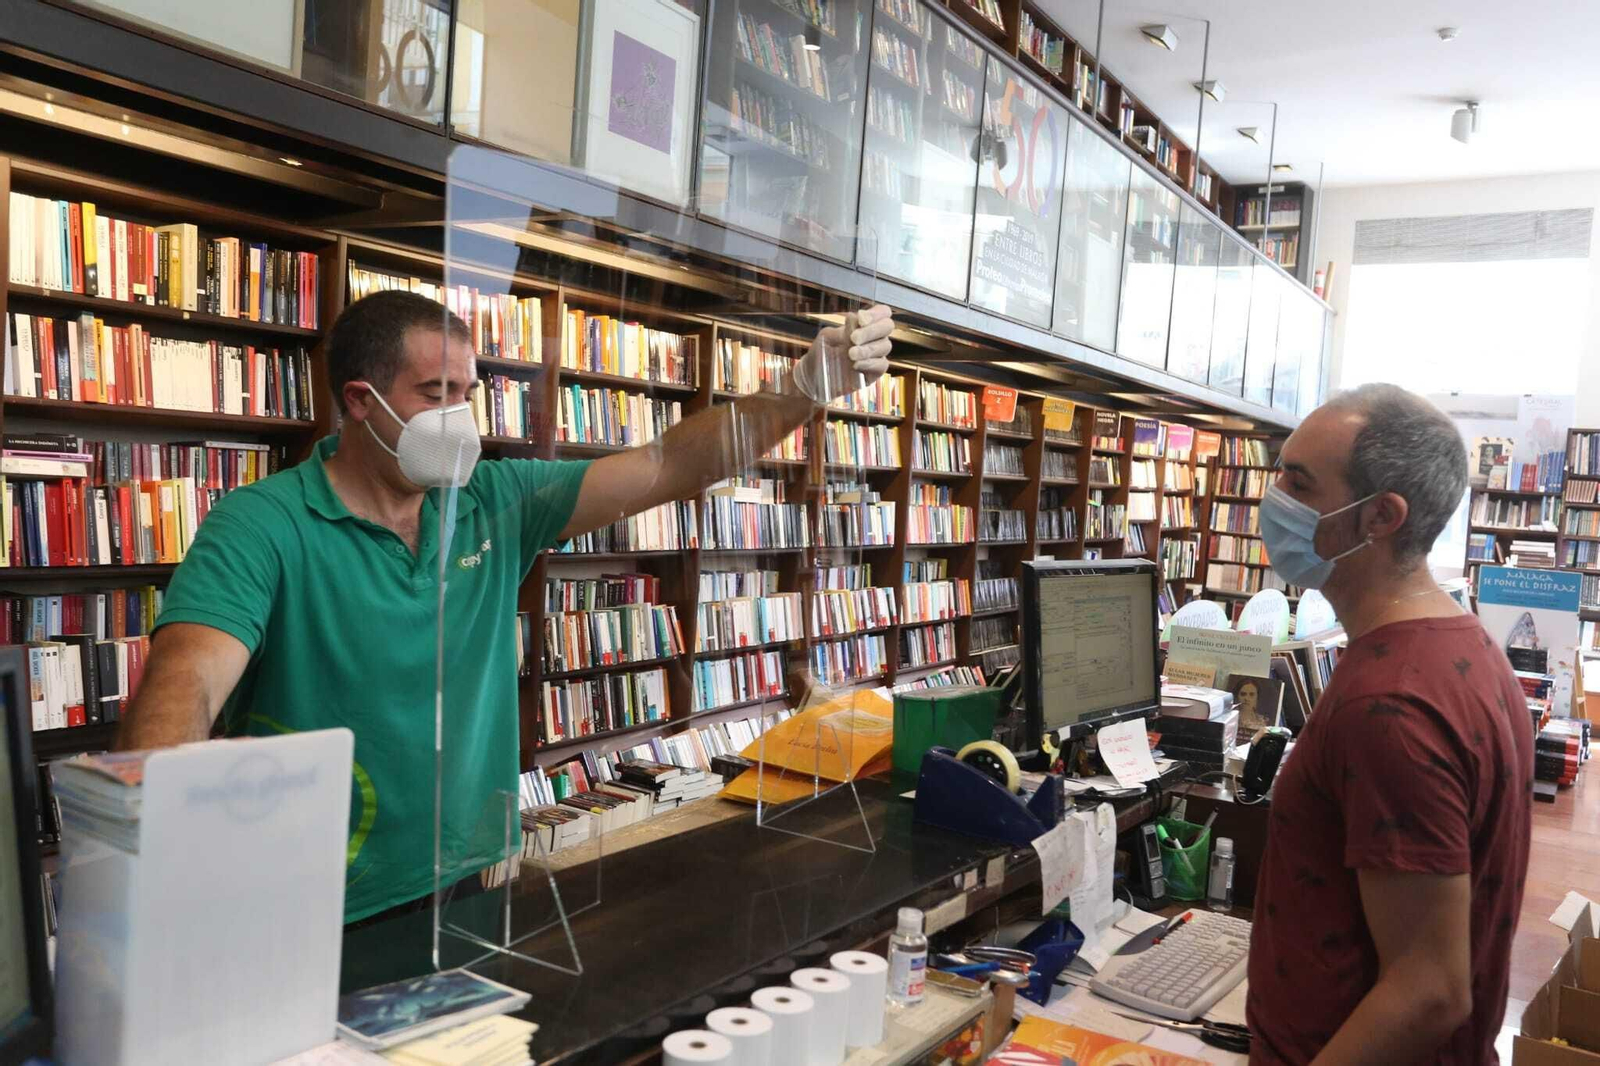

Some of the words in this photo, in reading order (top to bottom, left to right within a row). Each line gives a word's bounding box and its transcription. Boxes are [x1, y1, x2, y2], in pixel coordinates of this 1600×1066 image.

[995, 233, 1018, 255] ENTRE
[1096, 411, 1116, 419] NOVELA
[1135, 421, 1157, 430] POESÍA
[1484, 577, 1492, 585] SE
[1494, 579, 1516, 588] PONE
[1520, 581, 1530, 589] EL
[1533, 582, 1576, 593] DISFRAZ
[1176, 636, 1185, 644] El
[1186, 637, 1214, 647] infinito
[1239, 644, 1262, 653] junco
